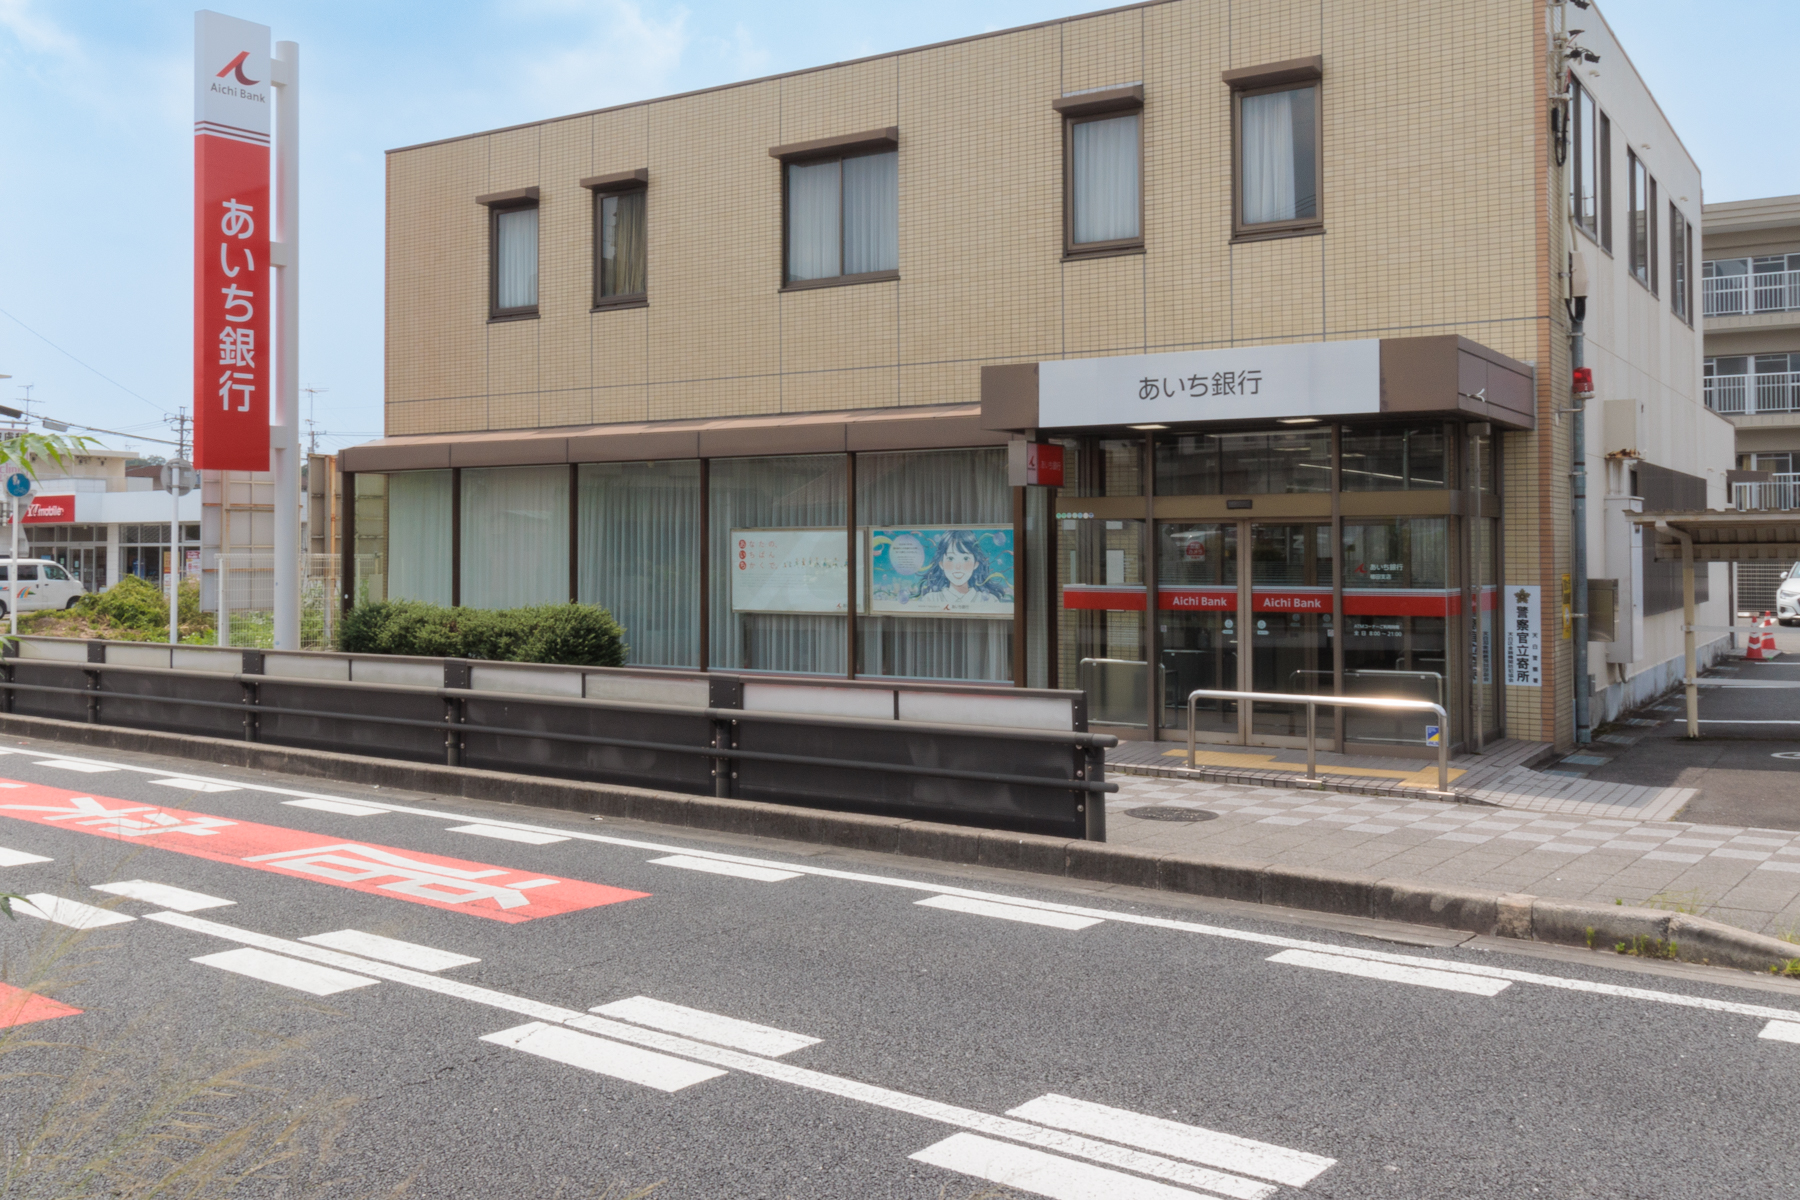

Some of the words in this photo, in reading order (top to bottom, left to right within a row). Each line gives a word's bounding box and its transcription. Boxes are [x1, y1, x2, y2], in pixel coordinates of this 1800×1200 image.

[210, 82, 238, 97] Aichi
[240, 88, 266, 104] Bank
[218, 198, 256, 412] あいち銀行
[1138, 369, 1262, 401] あいち銀行
[1369, 563, 1404, 571] あいち銀行
[1172, 596, 1199, 606] Aichi
[1201, 596, 1228, 607] Bank
[1263, 597, 1291, 608] Aichi
[1293, 598, 1321, 609] Bank
[1516, 605, 1530, 683] 警察官立寄所
